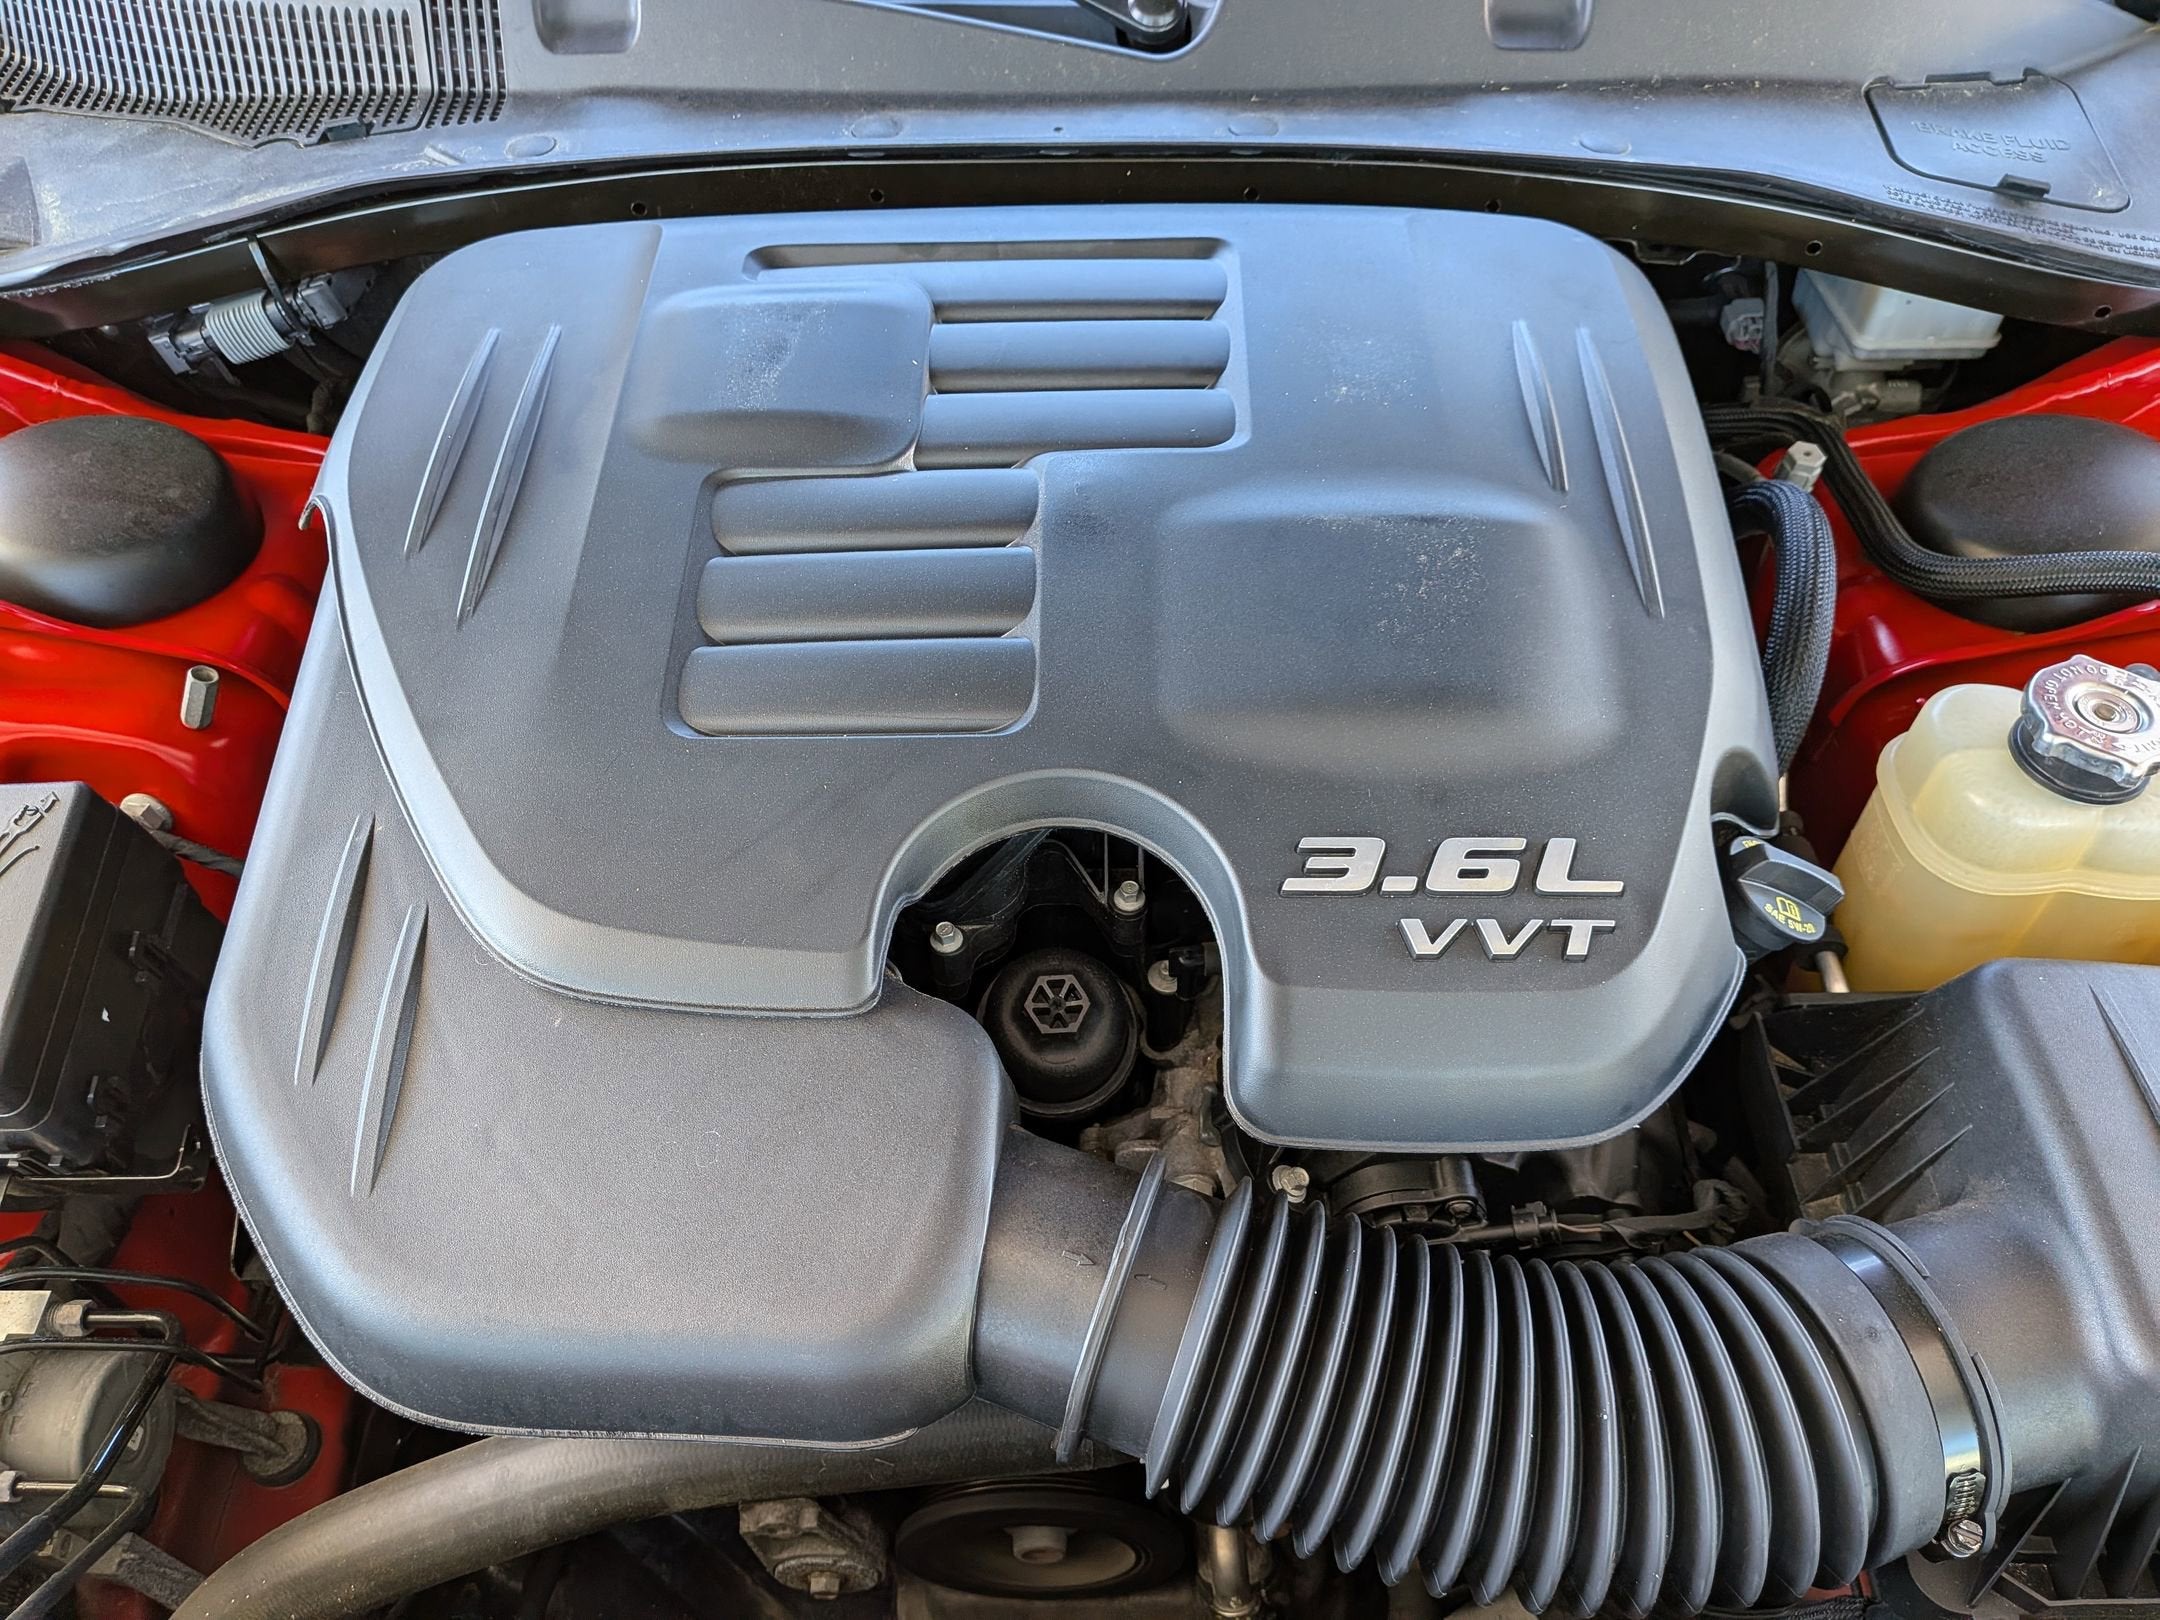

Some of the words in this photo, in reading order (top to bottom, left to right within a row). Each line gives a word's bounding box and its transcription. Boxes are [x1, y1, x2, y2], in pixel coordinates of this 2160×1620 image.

[1914, 122, 1998, 143] BRAKE
[2001, 135, 2071, 150] FLUID
[1952, 142, 2047, 163] ACCESS
[1280, 837, 1625, 896] 3.6L
[1764, 903, 1786, 925] SAE
[1398, 918, 1616, 960] VVT
